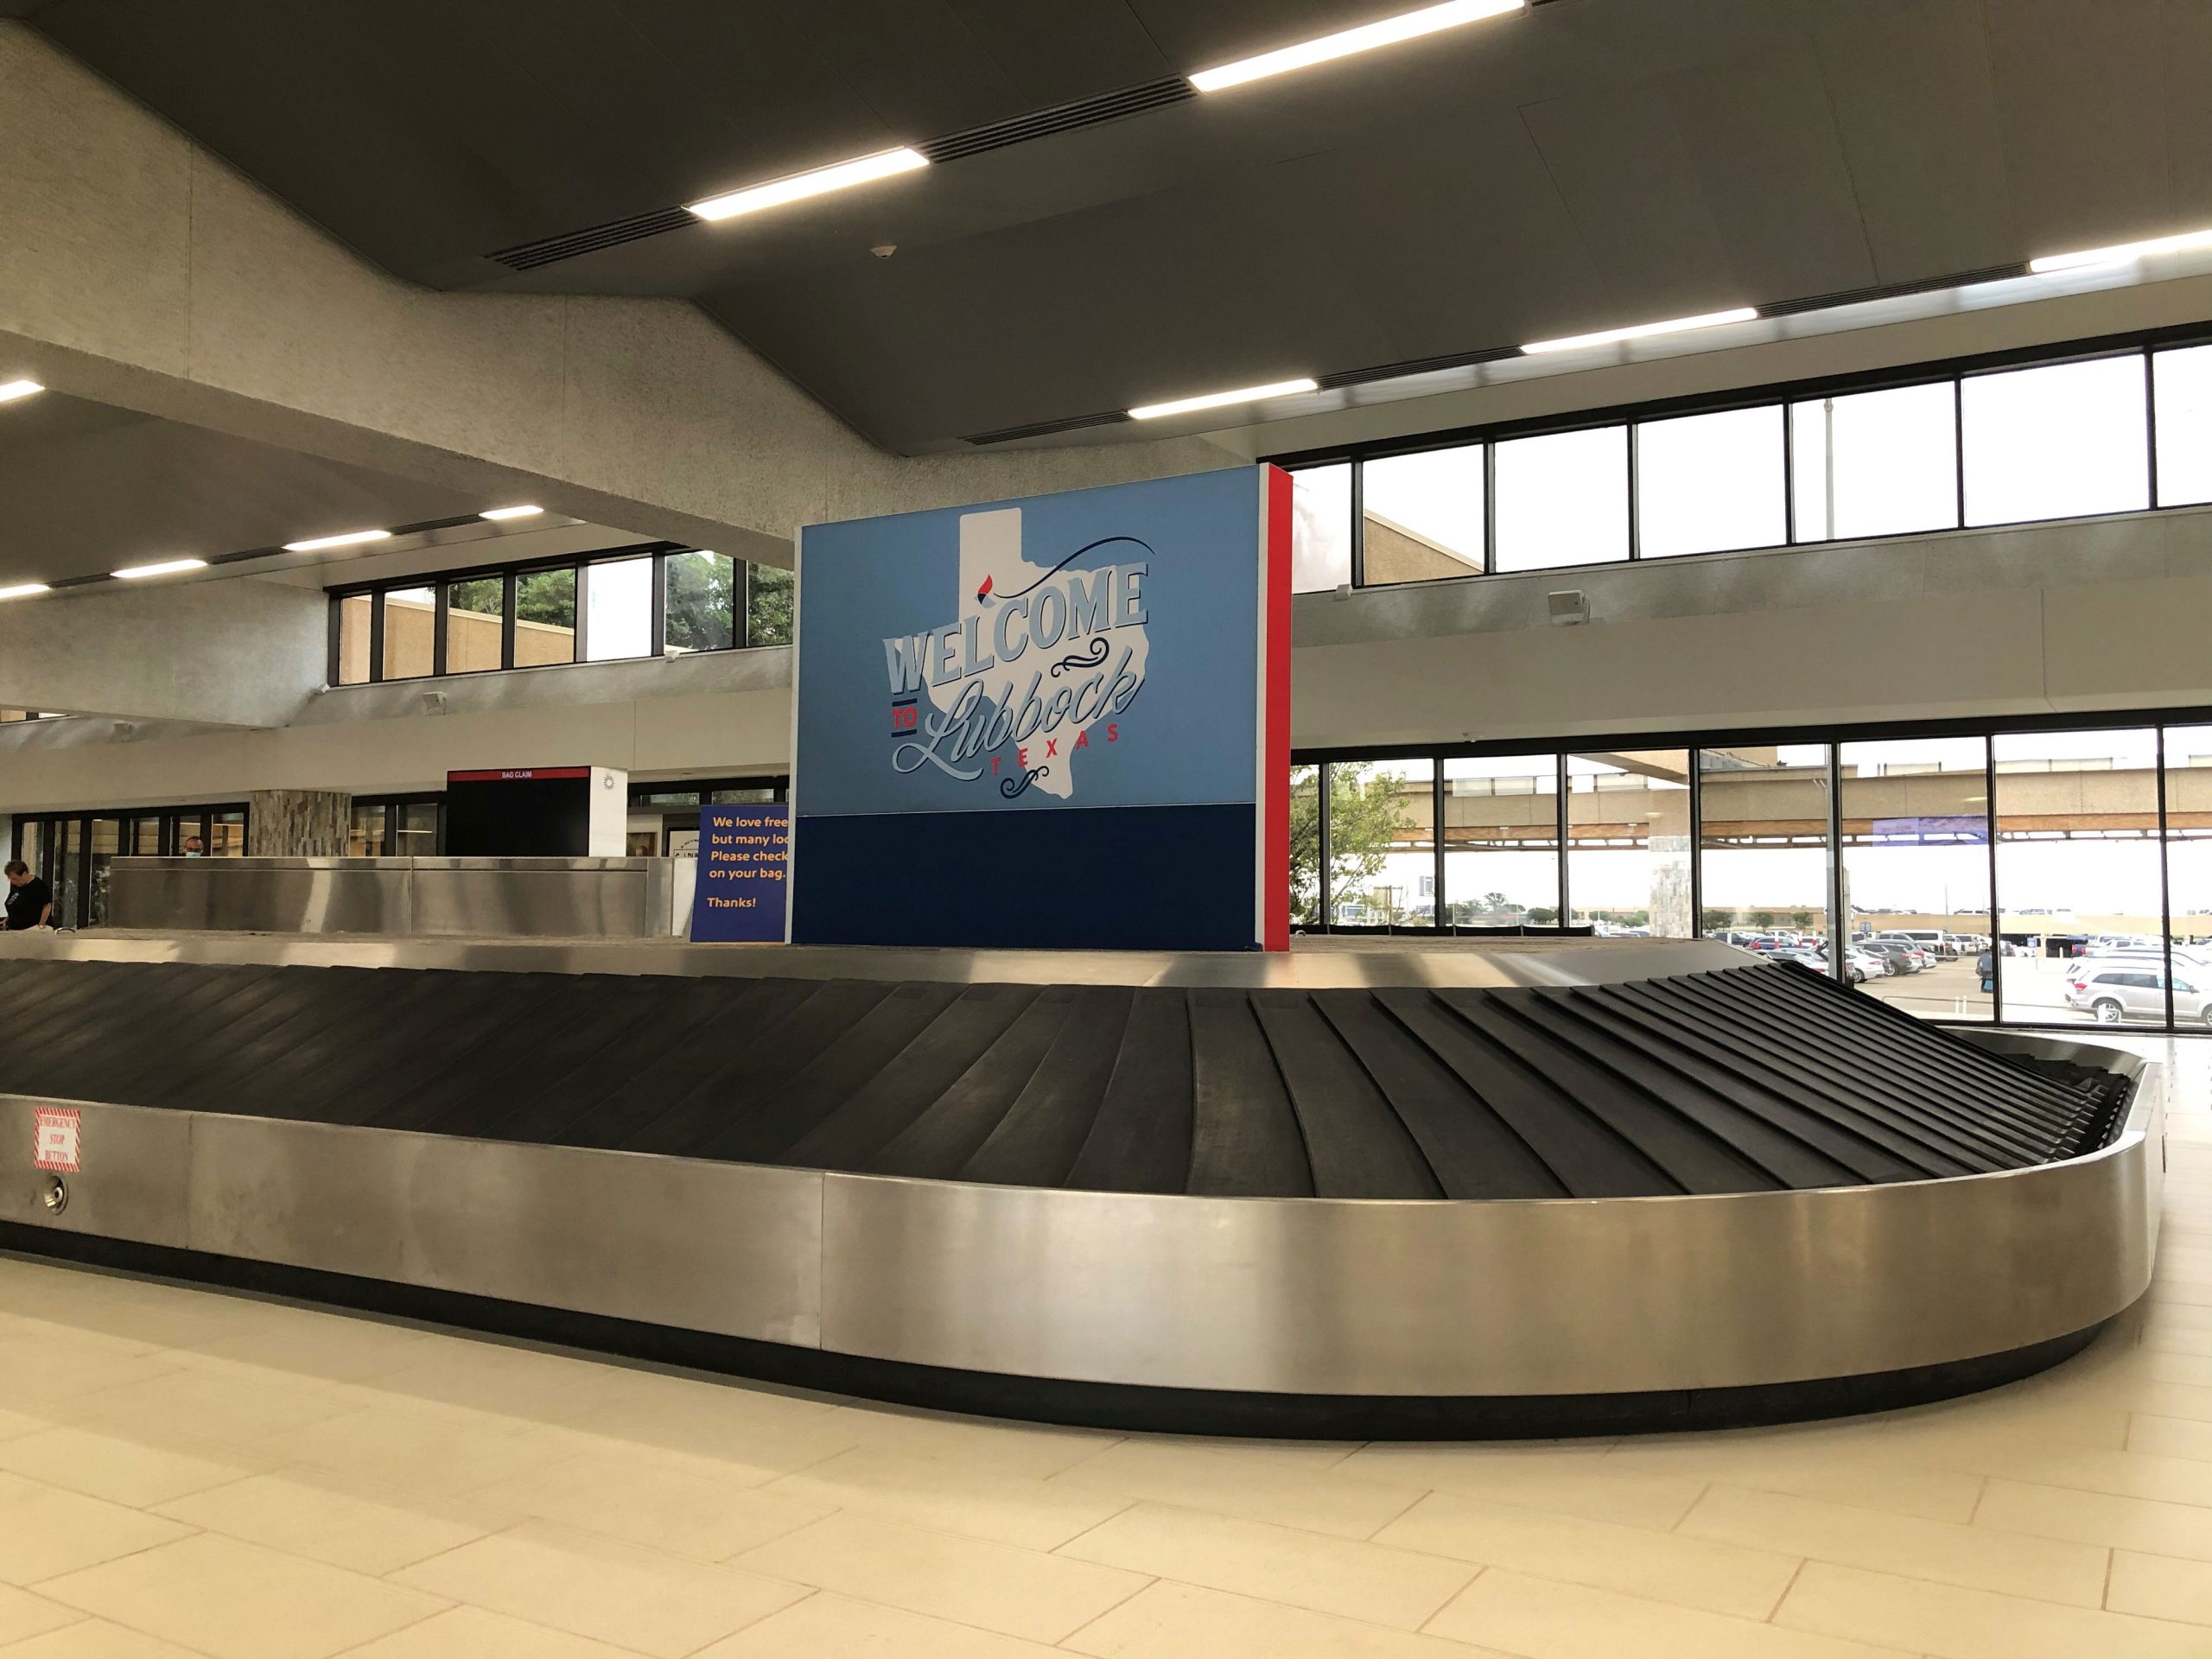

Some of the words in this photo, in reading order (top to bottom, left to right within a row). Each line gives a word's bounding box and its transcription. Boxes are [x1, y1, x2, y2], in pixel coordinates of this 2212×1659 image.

[882, 562, 1148, 696] WELCOME
[892, 645, 1145, 781] Lubbock
[892, 706, 918, 730] TO
[990, 723, 1119, 775] TEXAS
[515, 770, 532, 779] CLAIM
[713, 817, 733, 827] We
[736, 817, 761, 827] love
[765, 817, 788, 827] free
[712, 834, 733, 844] but
[735, 836, 770, 847] many
[710, 850, 750, 861] Please
[753, 850, 788, 861] check
[728, 870, 757, 880] your
[760, 868, 786, 880] bag.
[707, 897, 757, 908] Thanks!
[49, 1133, 66, 1145] STOP
